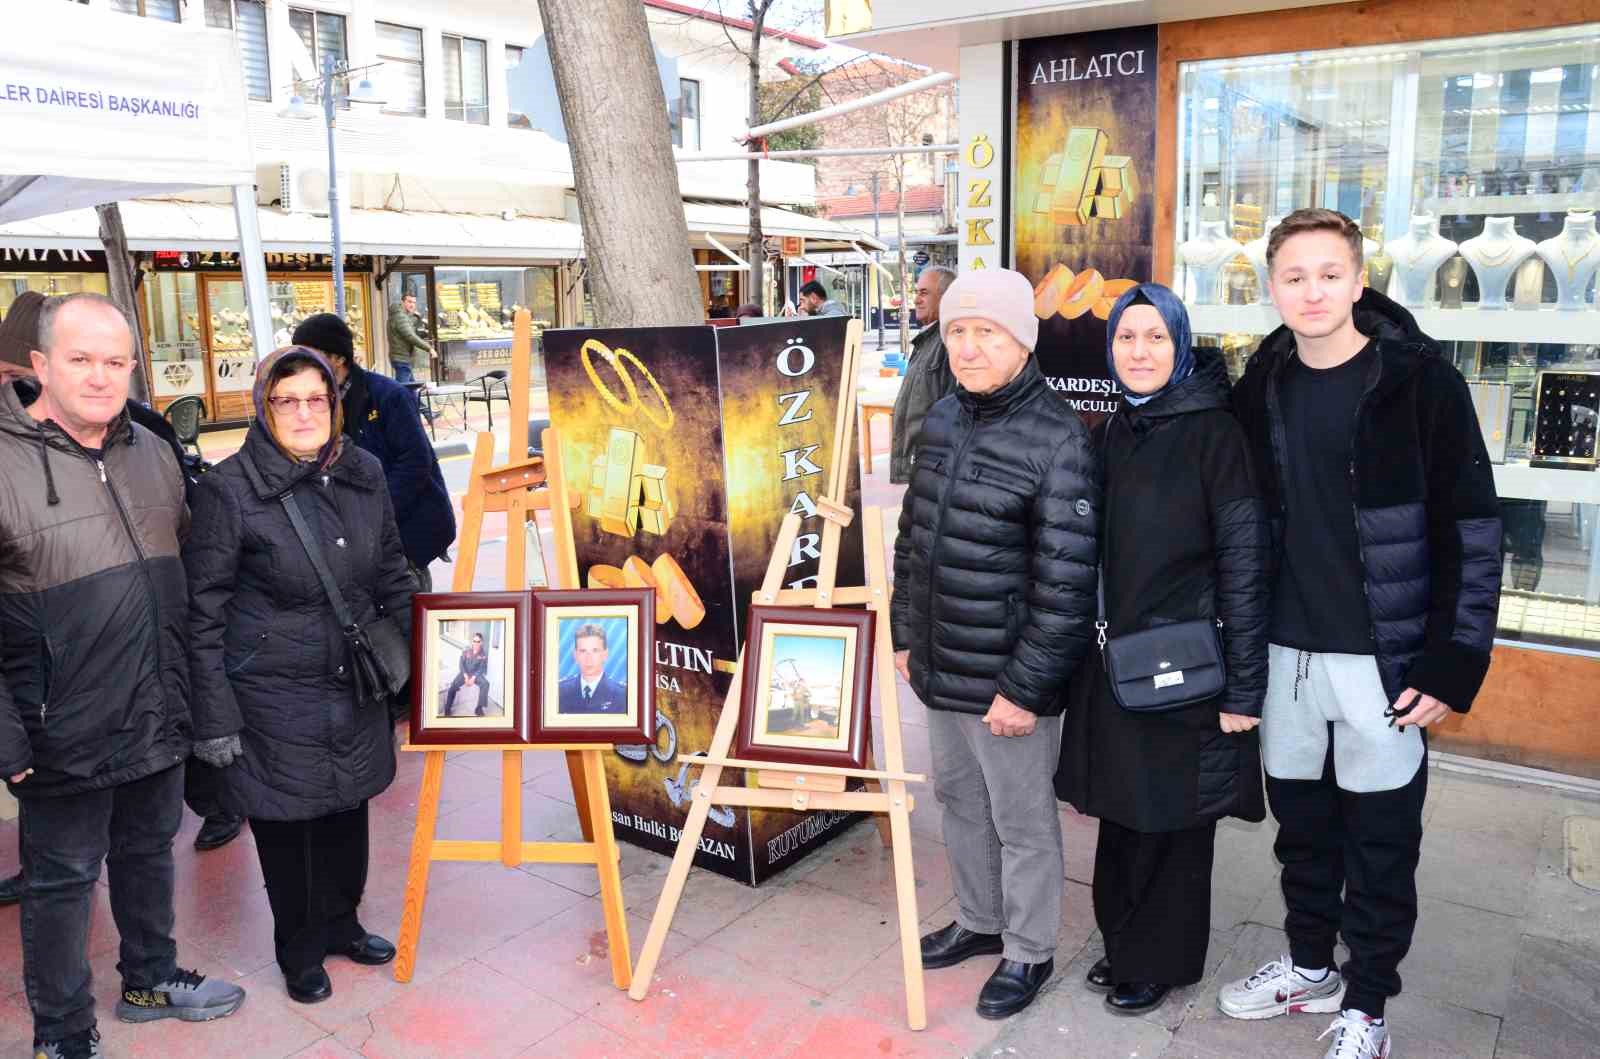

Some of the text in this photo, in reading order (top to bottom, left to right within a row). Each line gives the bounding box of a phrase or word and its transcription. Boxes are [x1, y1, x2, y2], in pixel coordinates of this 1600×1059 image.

[1030, 49, 1145, 85] AHLATCI
[0, 84, 199, 119] ER DAİRESİ BAŞKANLIĞI
[1065, 399, 1119, 413] MCULU
[633, 814, 667, 840] Hulki
